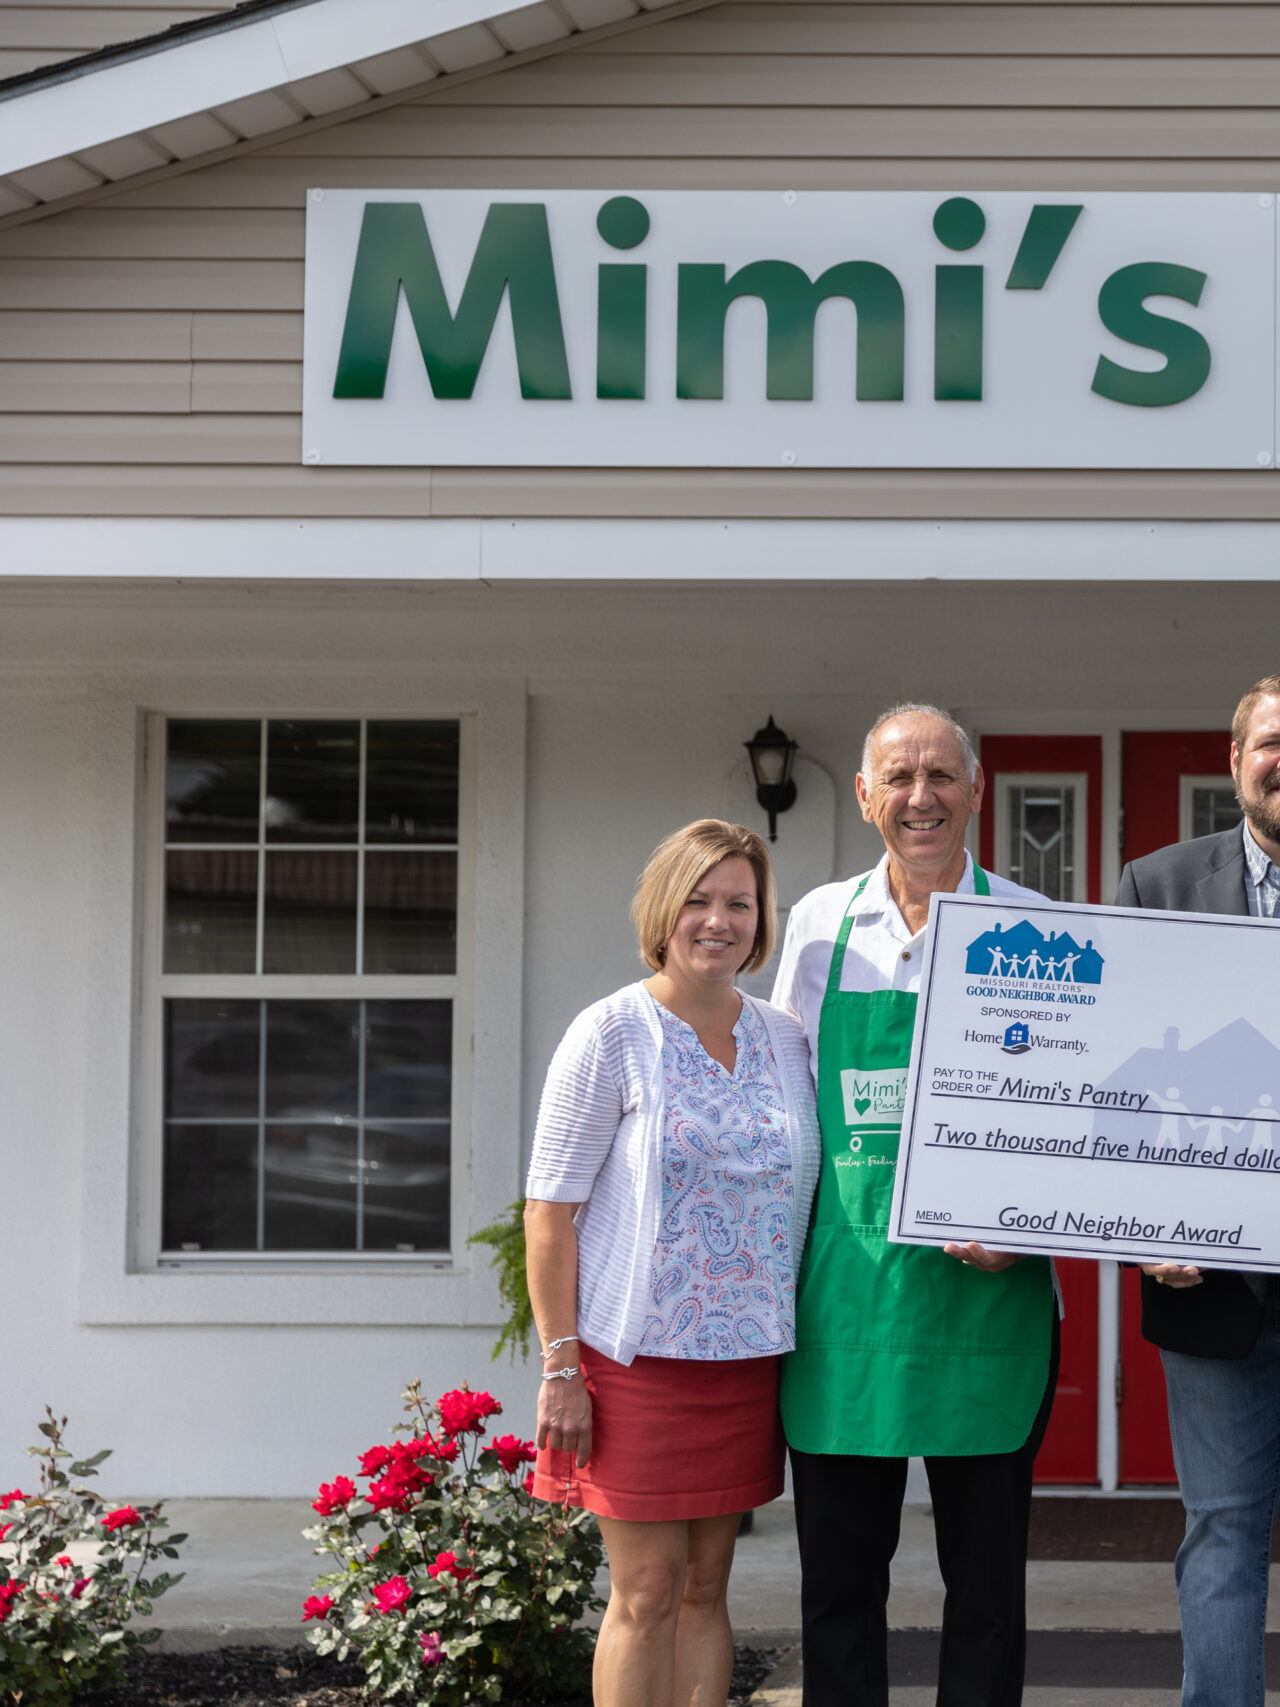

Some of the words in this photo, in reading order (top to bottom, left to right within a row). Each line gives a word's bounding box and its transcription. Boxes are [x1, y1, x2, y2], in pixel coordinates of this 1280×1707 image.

[333, 196, 1211, 407] Mimi's
[979, 977, 1028, 989] MISSOURI
[966, 985, 998, 998] GOOD
[999, 988, 1055, 1003] NEIGHBOR
[1056, 993, 1096, 1006] AWARD
[980, 1006, 1053, 1022] SPONSORED
[1055, 1012, 1072, 1023] BY
[964, 1029, 1003, 1044] Home
[1030, 1034, 1087, 1056] Warranty
[933, 1067, 954, 1079] PAY
[957, 1069, 972, 1080] TO
[976, 1070, 999, 1082] THE
[931, 1080, 972, 1093] ORDER
[974, 1083, 993, 1094] OF
[999, 1077, 1072, 1102] Mimi's
[1078, 1083, 1150, 1113] Pantry
[874, 1097, 906, 1111] Pant
[933, 1123, 977, 1146] Two
[984, 1128, 1087, 1155] thousand
[1090, 1136, 1129, 1160] five
[1136, 1140, 1227, 1166] hundred
[915, 1210, 952, 1222] MEMO
[998, 1206, 1058, 1231] Good
[1063, 1211, 1165, 1241] Neighbor
[1171, 1220, 1243, 1246] Award
